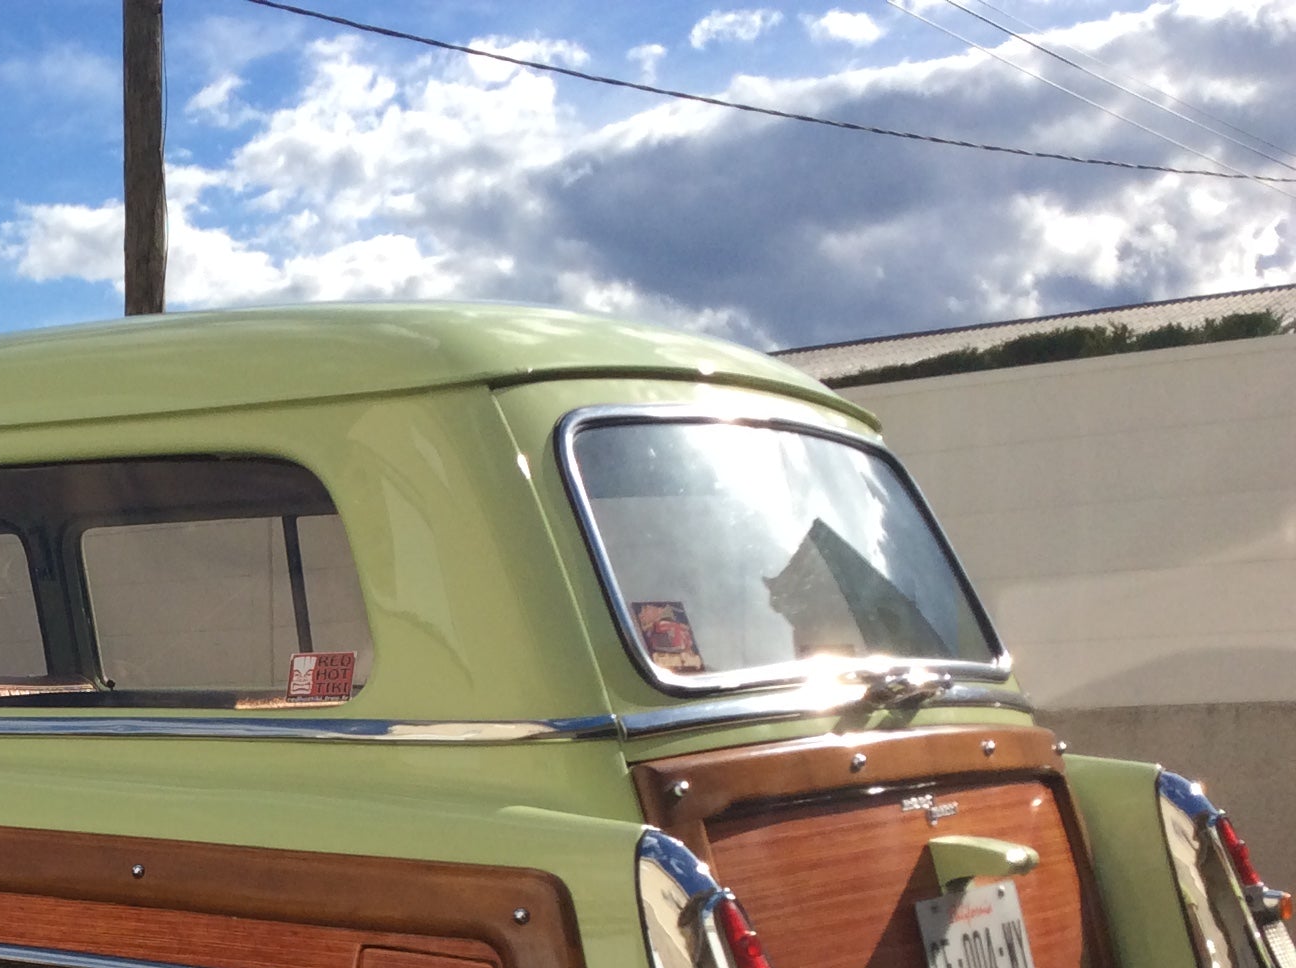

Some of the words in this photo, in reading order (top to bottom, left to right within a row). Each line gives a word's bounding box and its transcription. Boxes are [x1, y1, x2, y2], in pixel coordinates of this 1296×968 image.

[317, 655, 352, 668] RED
[315, 668, 351, 681] HOT
[314, 682, 349, 694] TIKI
